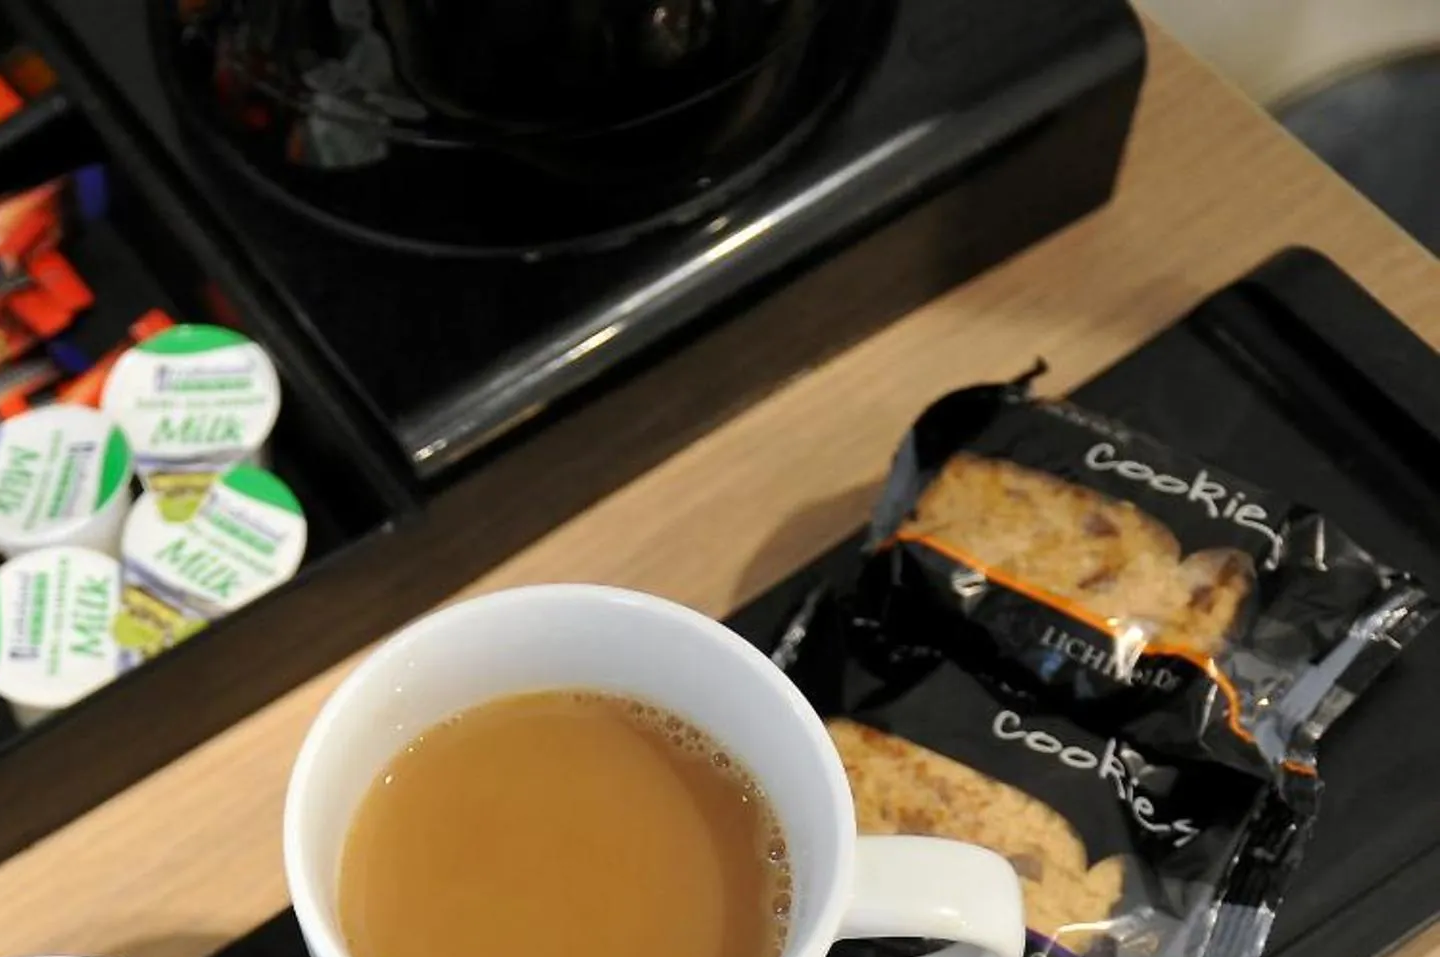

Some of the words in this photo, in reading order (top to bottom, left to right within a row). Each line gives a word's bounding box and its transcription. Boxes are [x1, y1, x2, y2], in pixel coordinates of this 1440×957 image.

[150, 408, 244, 445] Milk
[153, 536, 248, 599] Milk
[70, 577, 109, 658] Milk
